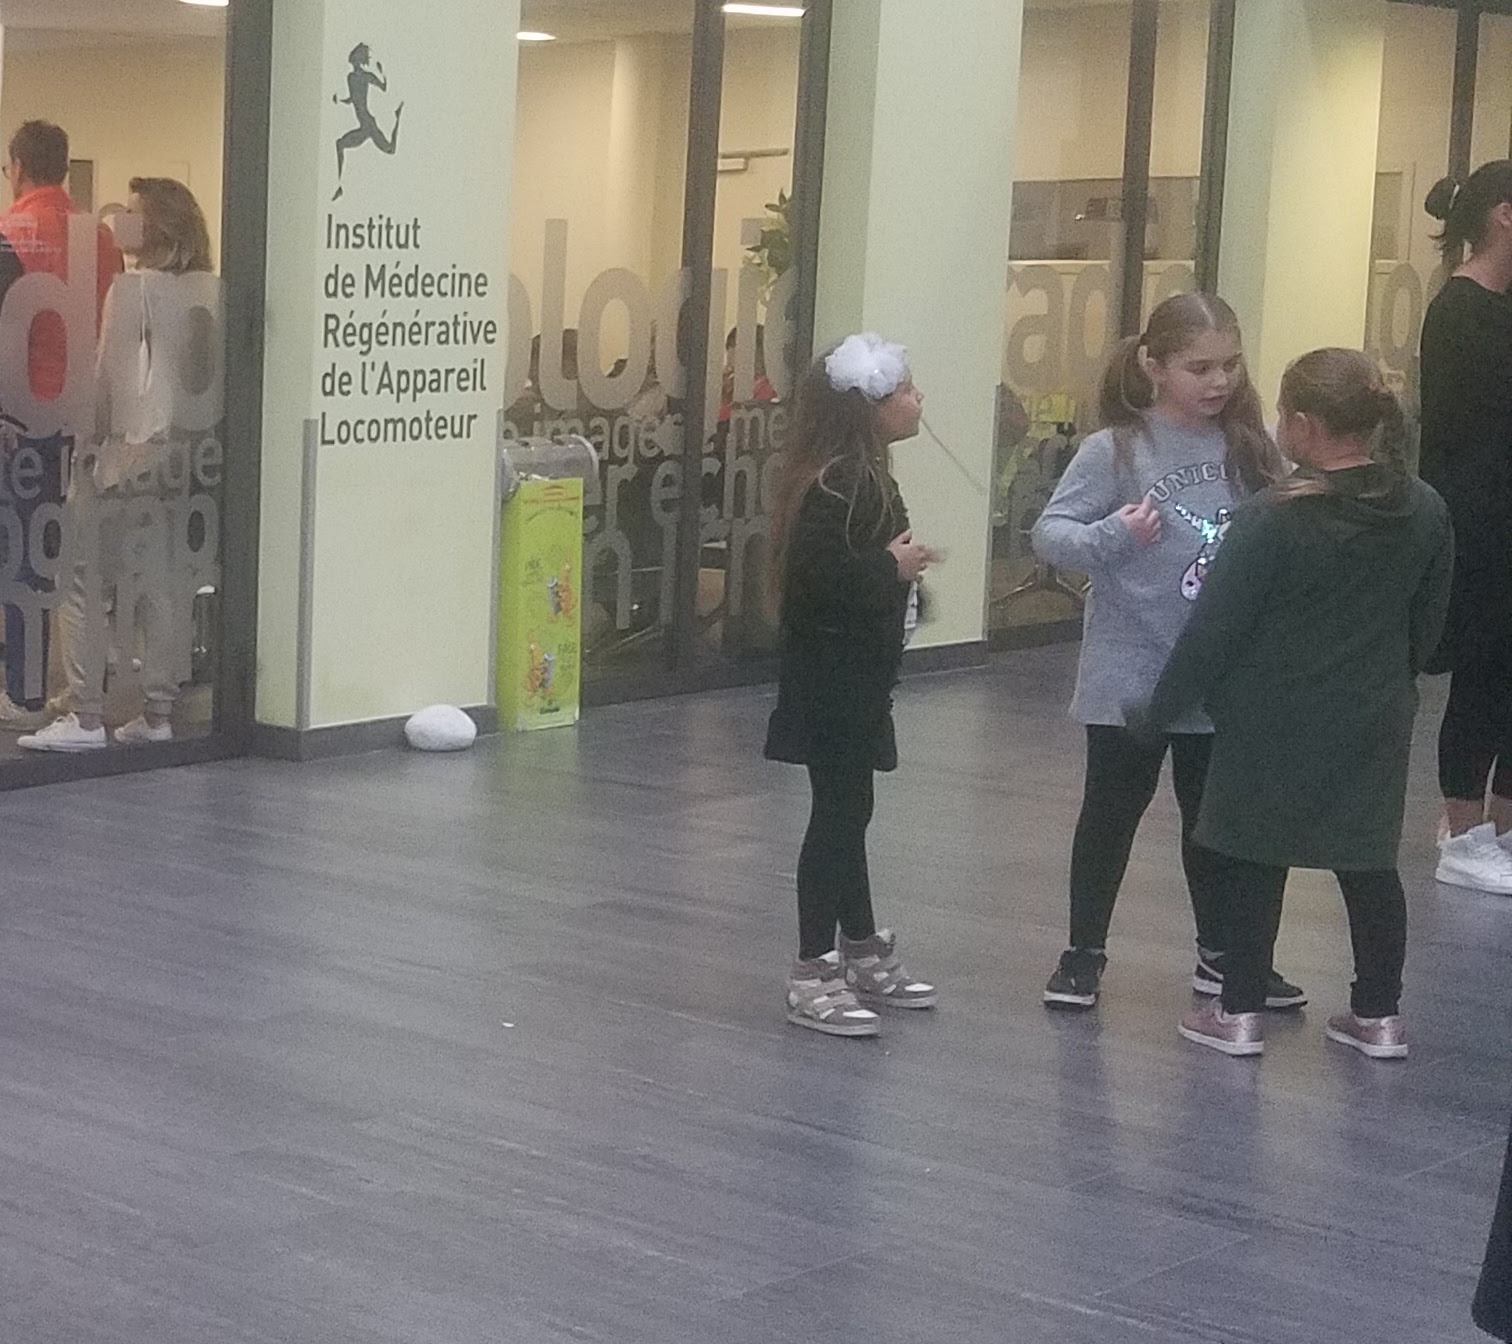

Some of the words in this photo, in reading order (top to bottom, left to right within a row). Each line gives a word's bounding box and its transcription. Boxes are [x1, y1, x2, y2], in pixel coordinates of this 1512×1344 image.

[326, 214, 422, 251] Institut
[323, 265, 356, 299] de
[364, 260, 489, 300] Médecine
[322, 311, 498, 356] Régénérative
[321, 364, 353, 398] de
[360, 358, 487, 402] l'Appareil
[320, 408, 478, 447] Locomoteur
